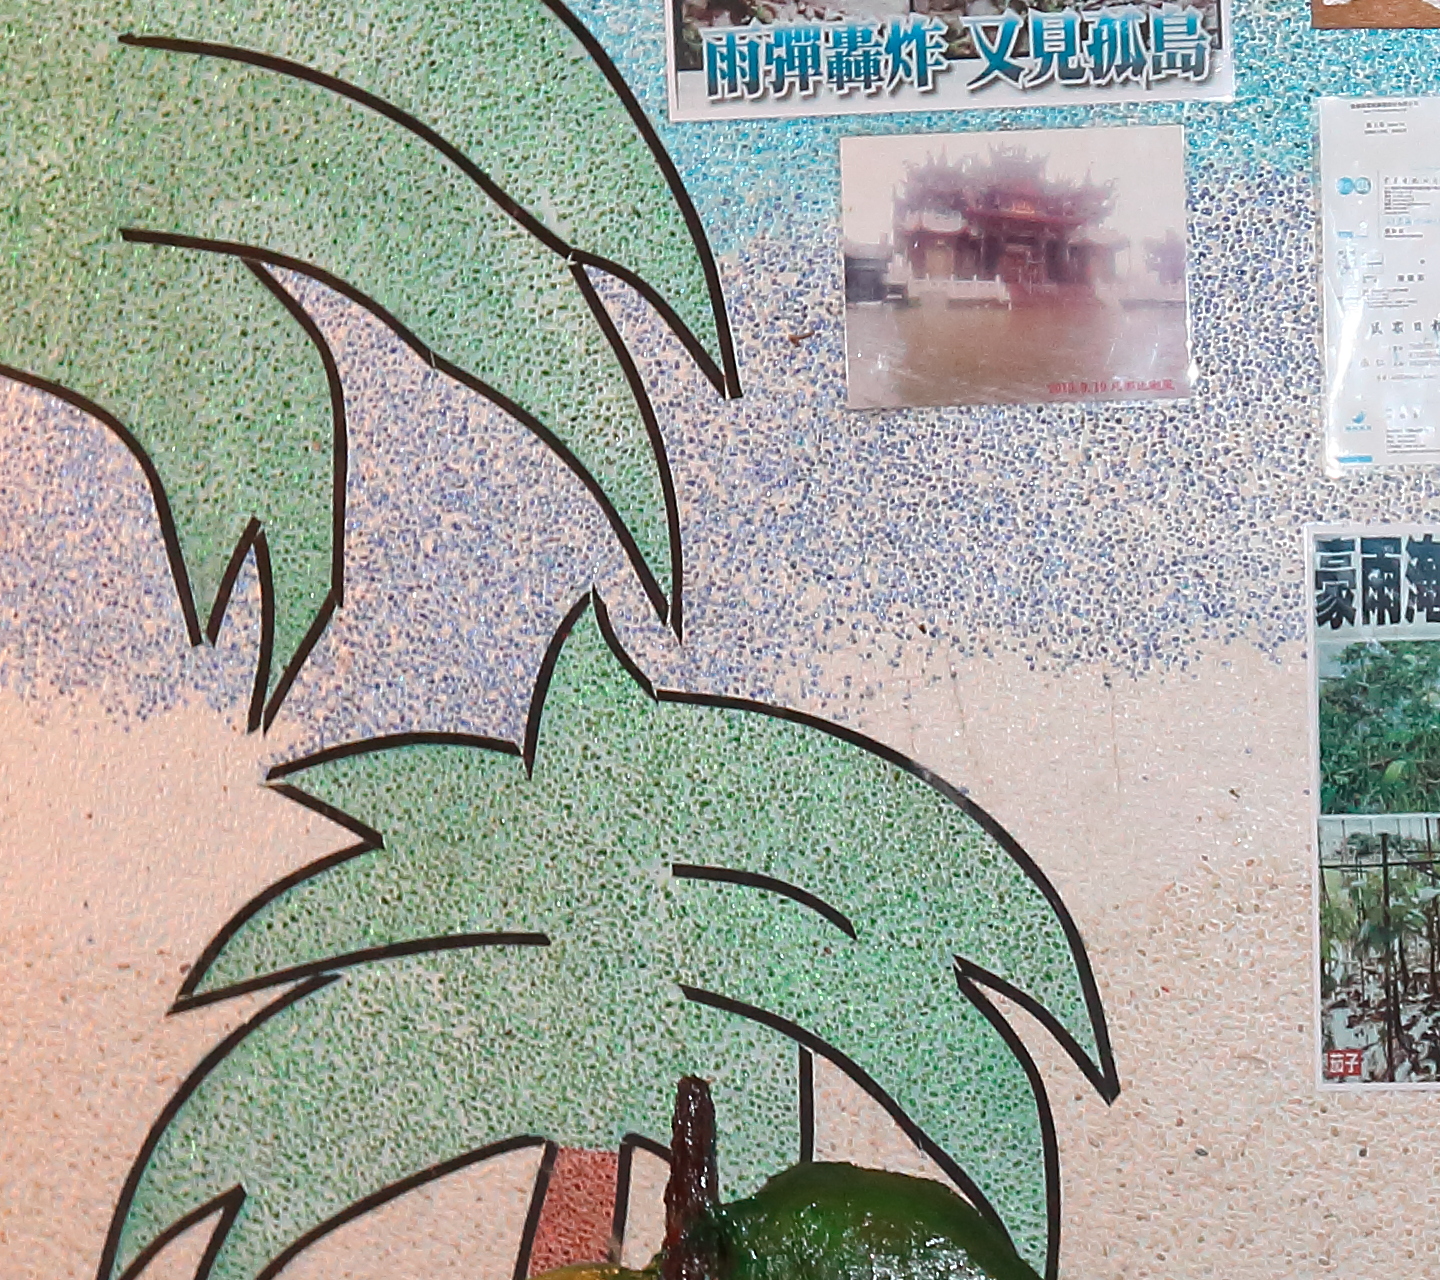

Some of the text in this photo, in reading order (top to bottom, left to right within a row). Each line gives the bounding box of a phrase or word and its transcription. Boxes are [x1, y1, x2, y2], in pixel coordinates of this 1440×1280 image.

[701, 3, 1214, 101] 雨彈轟炸 又見孤島
